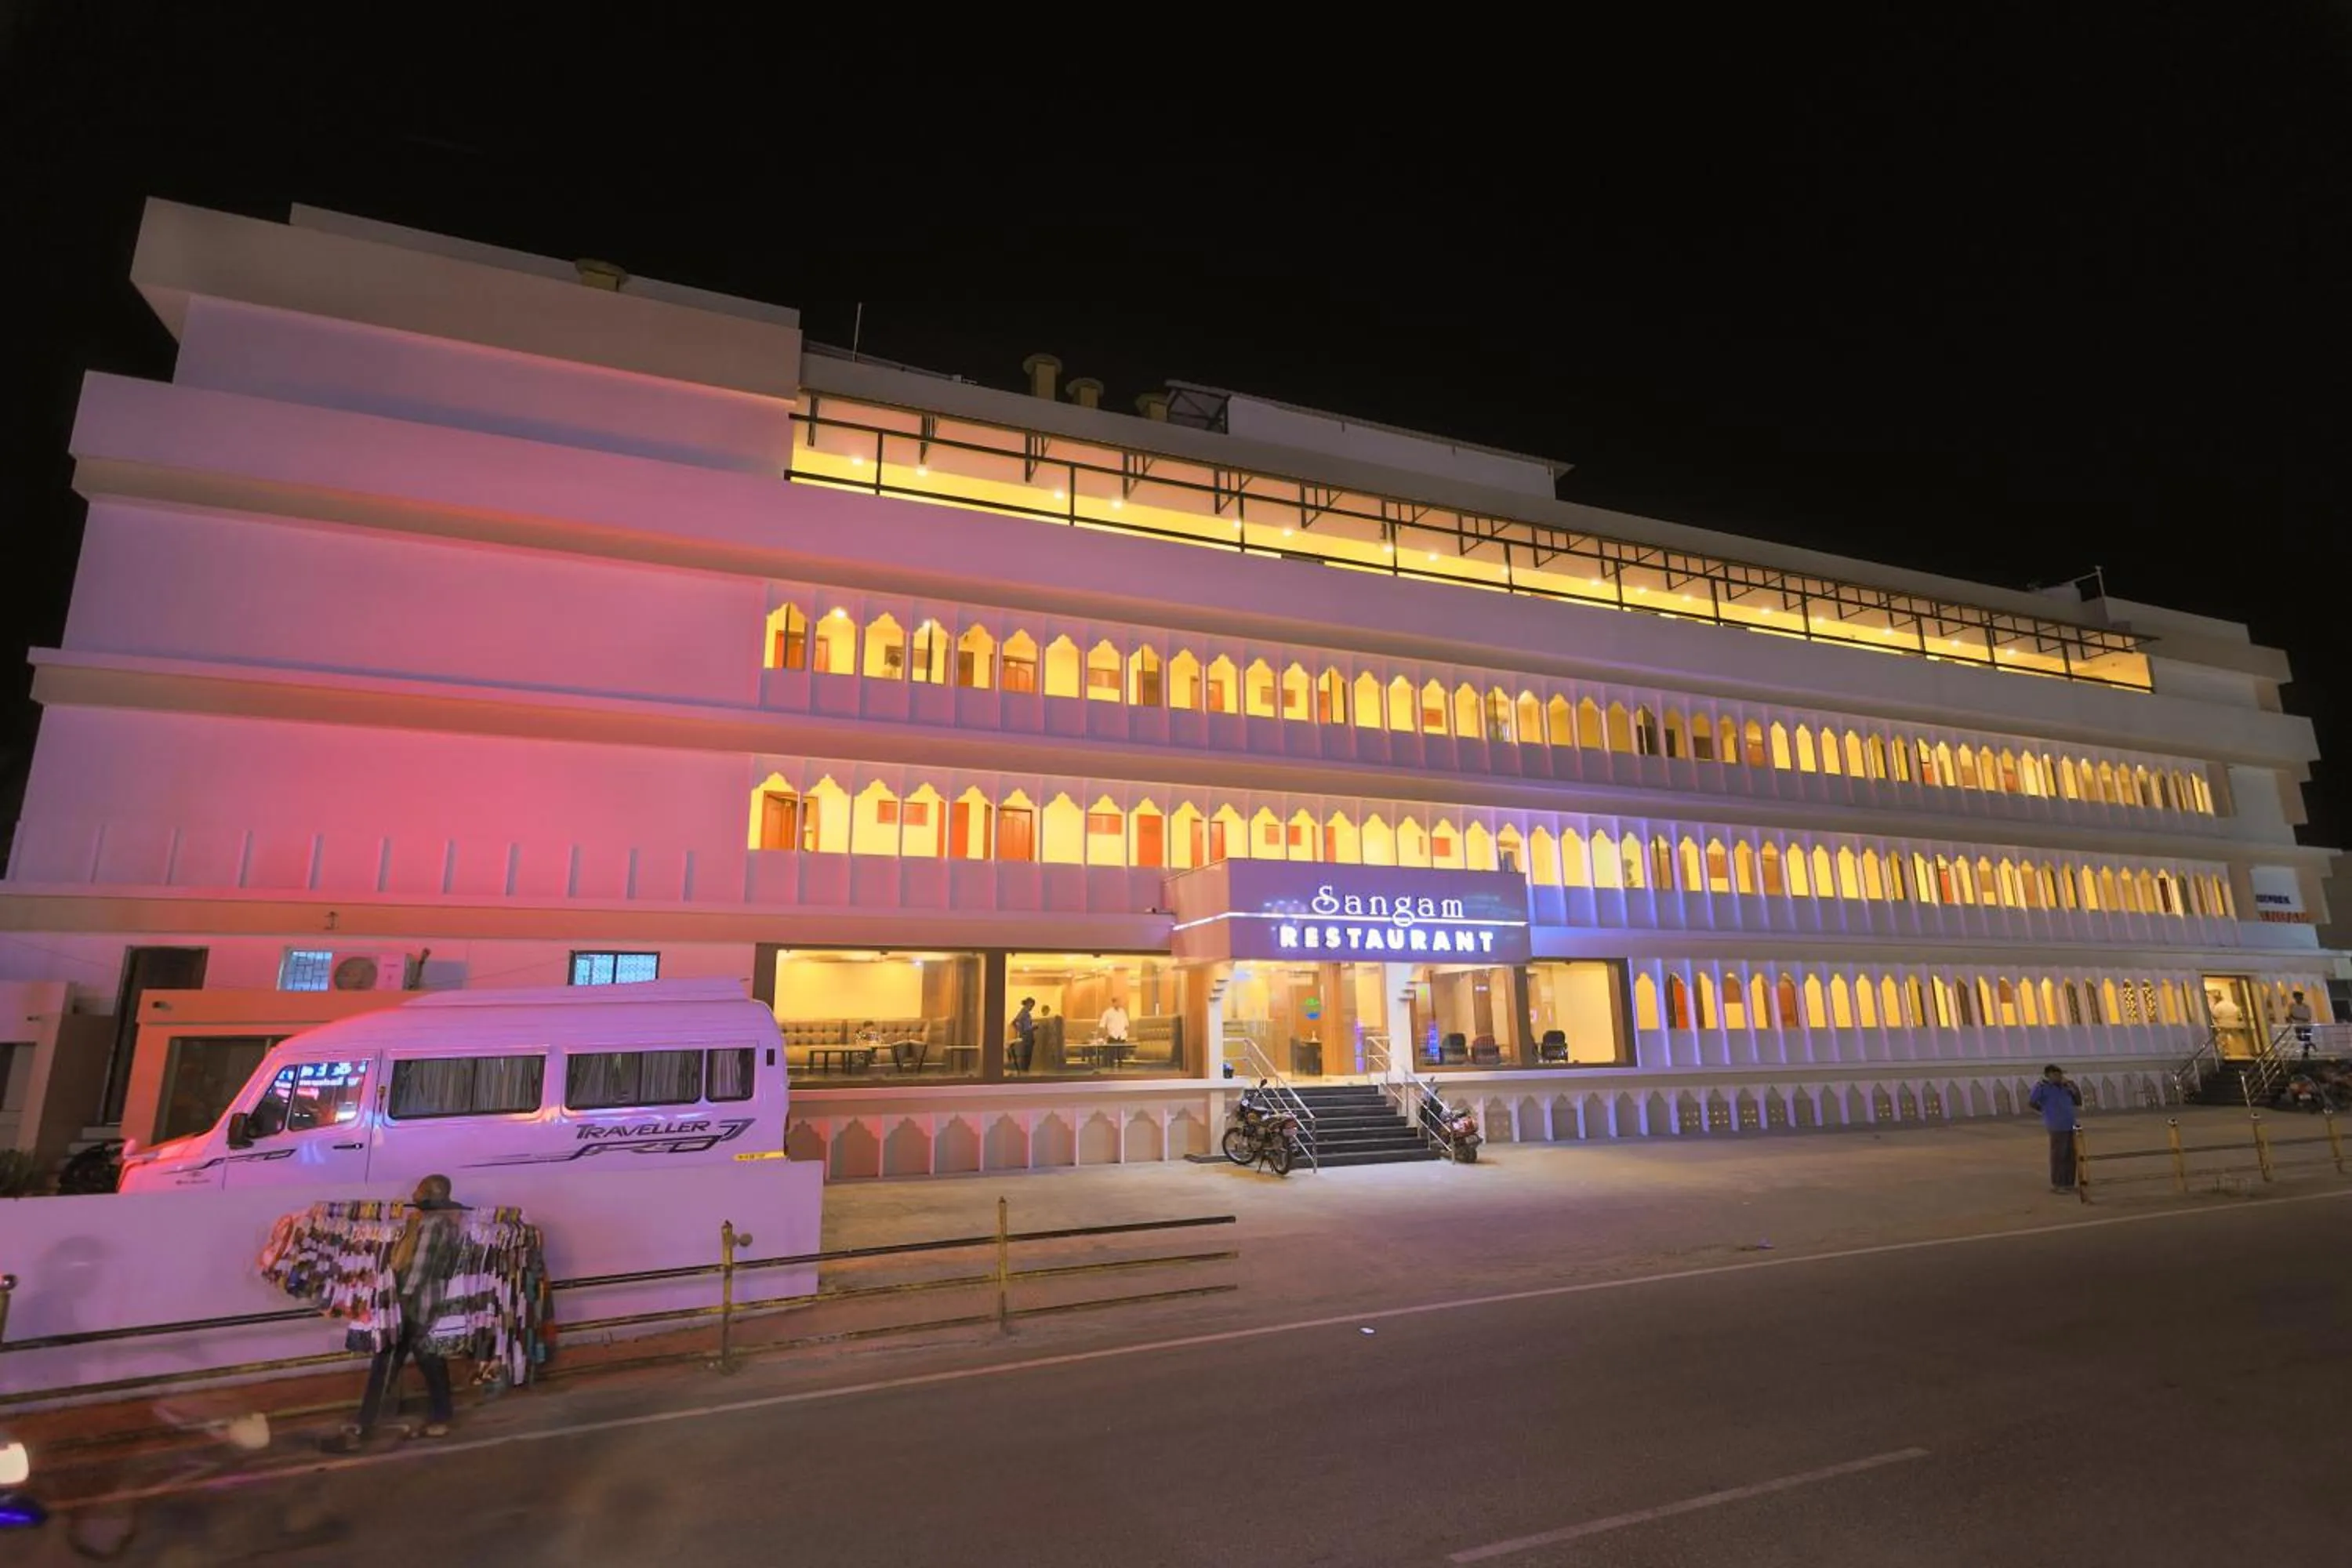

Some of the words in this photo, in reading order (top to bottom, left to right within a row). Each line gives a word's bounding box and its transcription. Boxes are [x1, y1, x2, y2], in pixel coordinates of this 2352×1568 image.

[1312, 885, 1465, 926] Sangam
[1279, 926, 1494, 952] RESTAURANT
[577, 1120, 710, 1139] TRAVELLER
